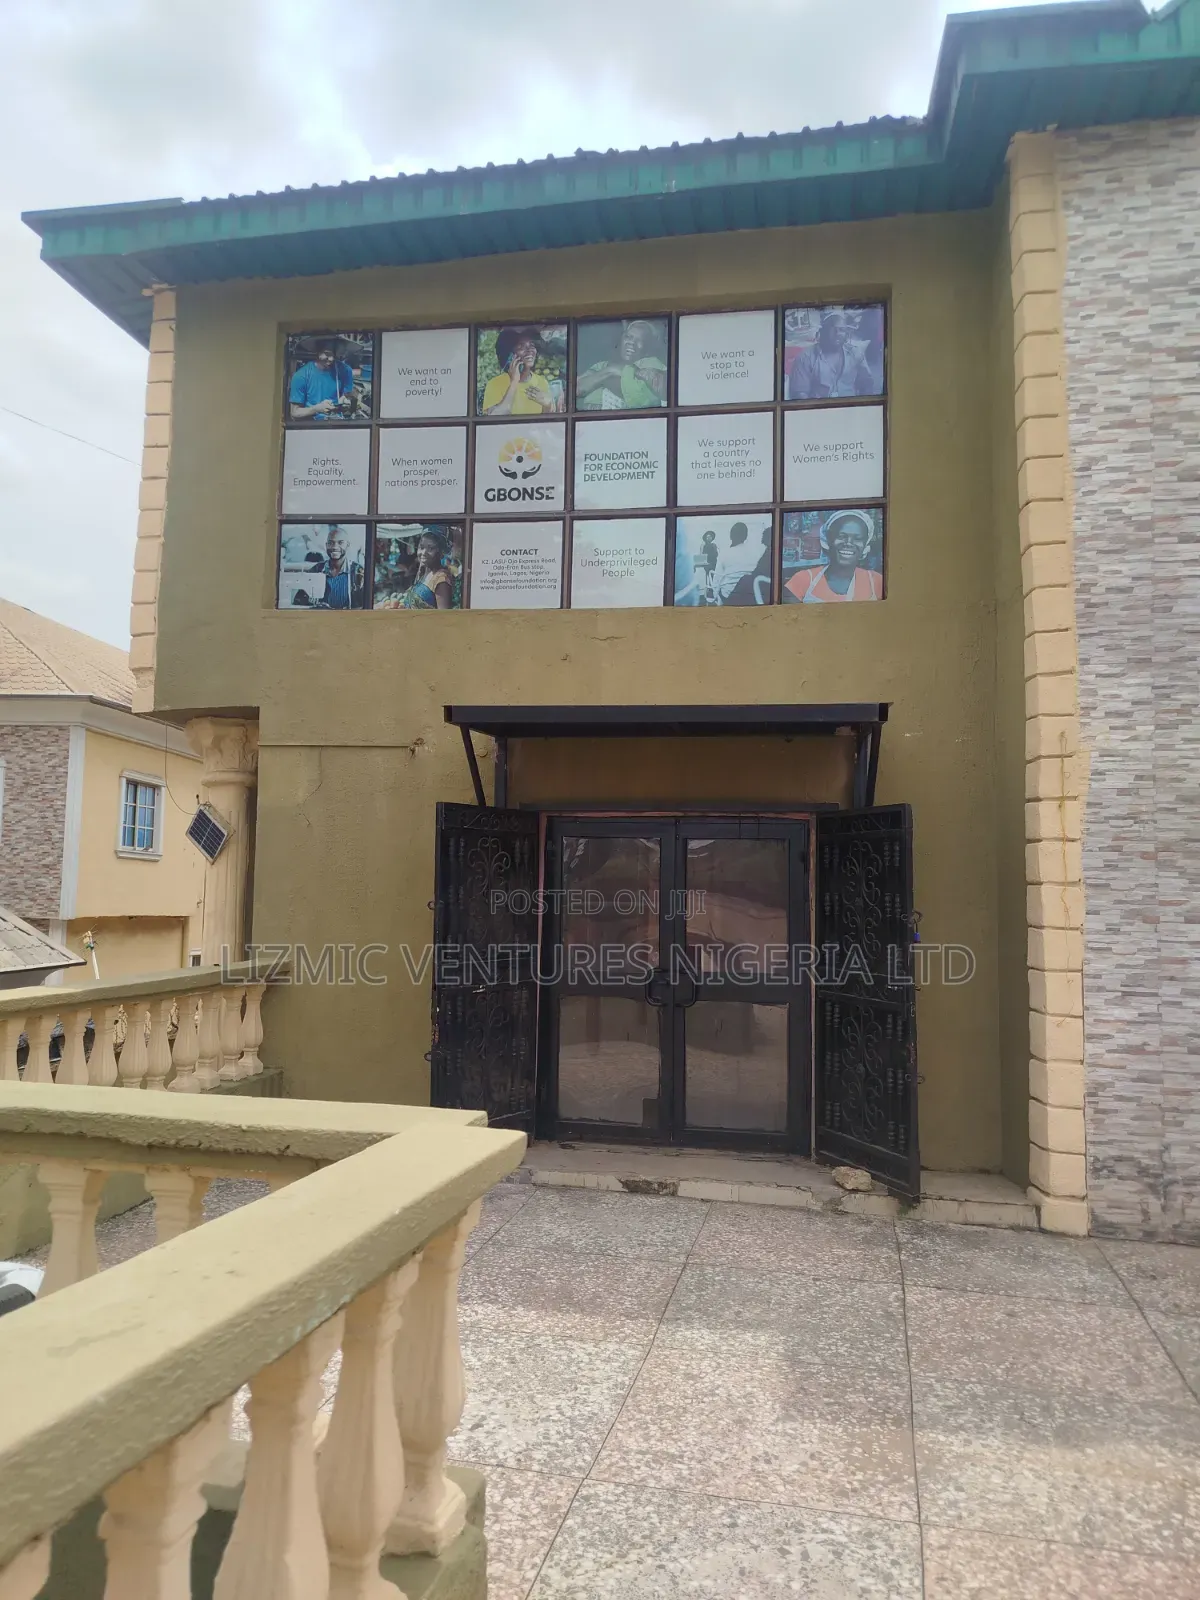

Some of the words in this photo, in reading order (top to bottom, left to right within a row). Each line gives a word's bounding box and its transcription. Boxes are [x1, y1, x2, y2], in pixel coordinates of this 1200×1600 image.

[701, 351, 718, 359] We
[720, 350, 746, 359] want
[710, 361, 731, 370] stop
[398, 368, 413, 376] We
[706, 369, 749, 380] violence!
[409, 378, 427, 386] end
[405, 387, 442, 398] poverty!
[698, 438, 714, 447] We
[717, 437, 756, 447] support
[803, 443, 820, 452] We
[823, 441, 864, 452] support
[584, 451, 649, 462] FOUNDATION
[712, 449, 750, 457] country
[792, 453, 839, 464] Women's
[842, 451, 875, 462] Rights
[312, 457, 342, 467] Rights.
[391, 457, 418, 466] When
[420, 458, 453, 466] women
[584, 463, 603, 472] FOR
[605, 460, 659, 471] ECONOMIC
[691, 460, 711, 469] that
[714, 459, 746, 468] leaves
[749, 459, 762, 467] no
[308, 467, 345, 477] Equality.
[403, 469, 440, 478] prosper,
[583, 470, 655, 482] DEVELOPMENT
[696, 472, 715, 480] one
[718, 469, 755, 479] behind!
[293, 478, 359, 487] Empowerment.
[385, 478, 419, 487] nations
[421, 478, 458, 487] prosper.
[484, 486, 555, 502] GBONSE
[500, 548, 539, 556] CONTACT
[593, 547, 632, 557] Support
[580, 556, 658, 568] Underprivileged
[602, 568, 635, 578] People
